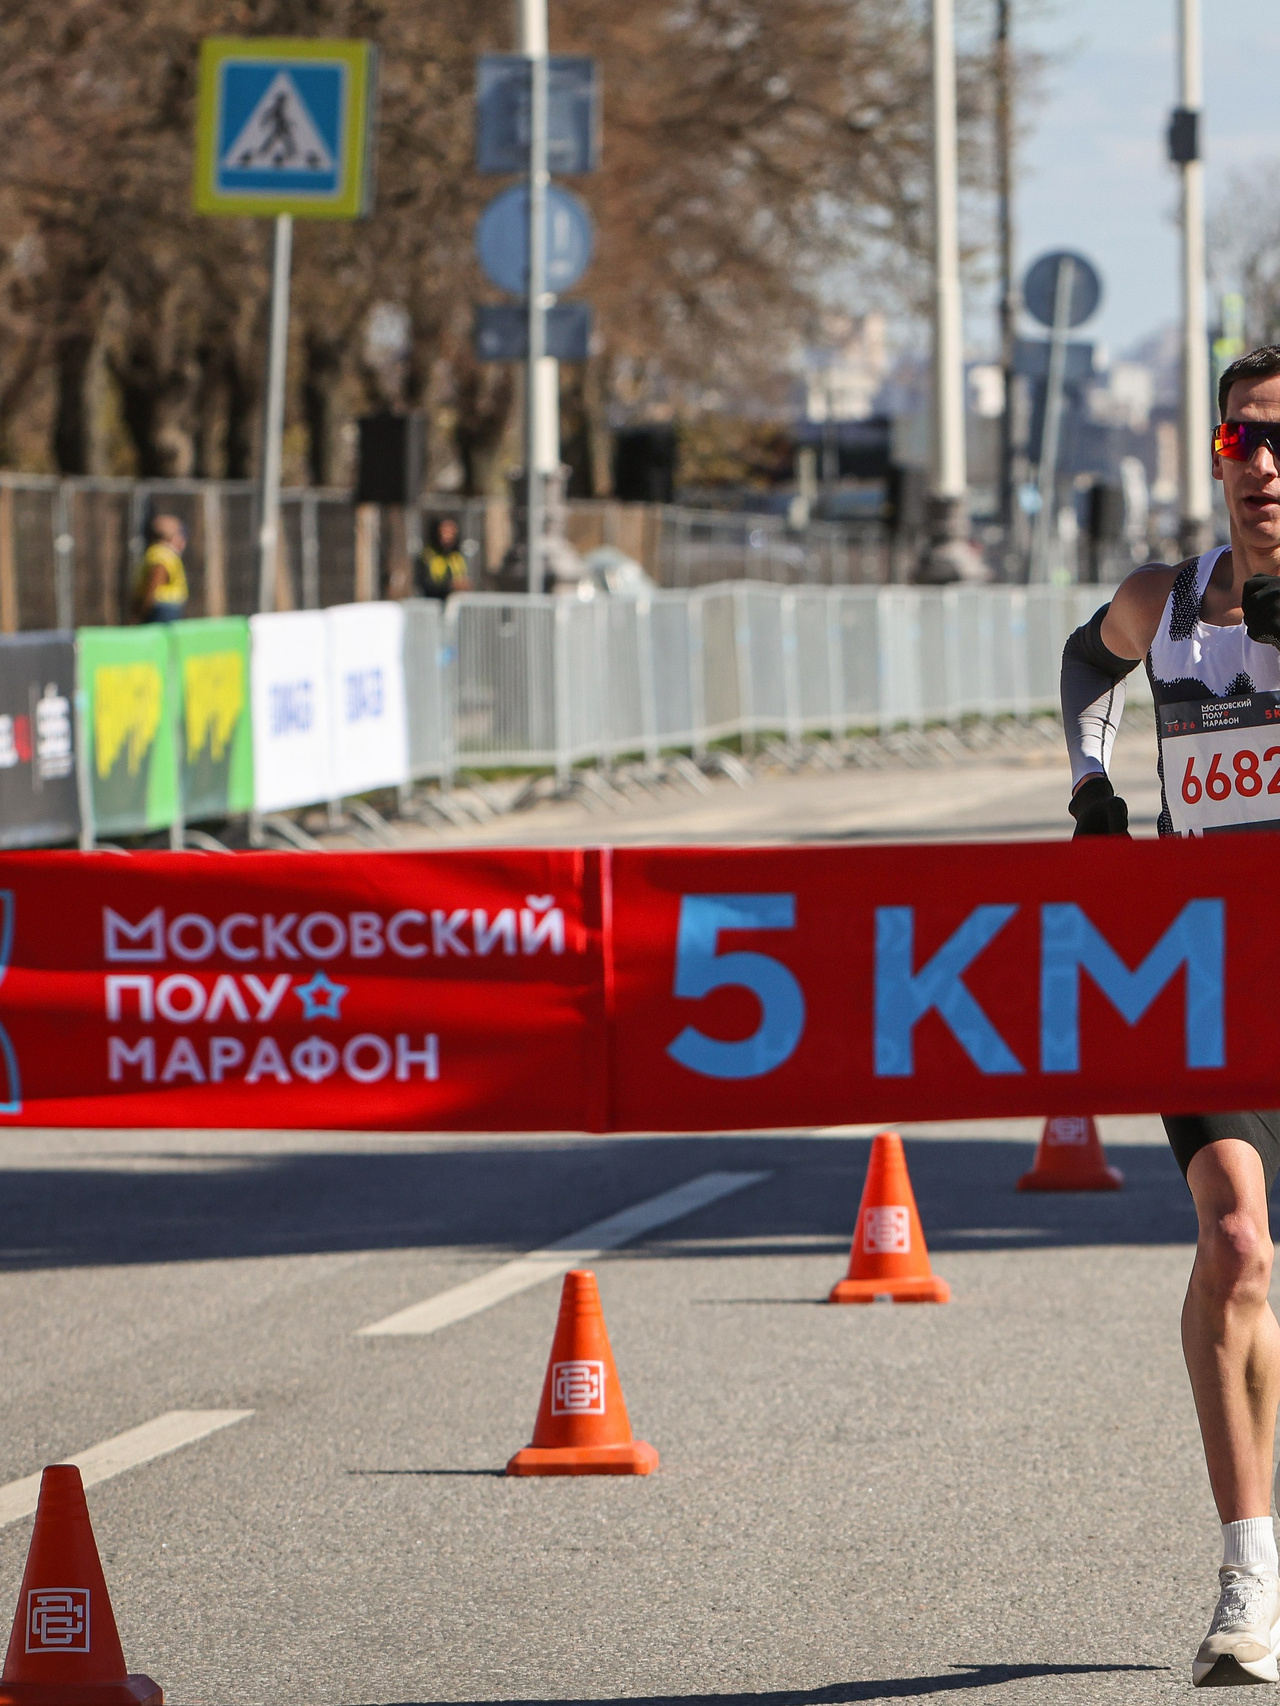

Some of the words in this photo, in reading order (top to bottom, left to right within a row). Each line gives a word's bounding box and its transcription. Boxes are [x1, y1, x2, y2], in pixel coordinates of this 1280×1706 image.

[1201, 699, 1252, 712] МОСКОВСКИЙ
[1202, 711, 1223, 719] ПОЛУ
[1265, 709, 1273, 720] 5
[1167, 722, 1195, 732] 2026
[1202, 717, 1240, 728] МАРАФОН
[102, 894, 566, 962] МОСКОВСКИЙ
[664, 892, 807, 1080] 5
[104, 973, 292, 1023] ПОЛУ
[107, 1032, 441, 1084] МАРАФОН
